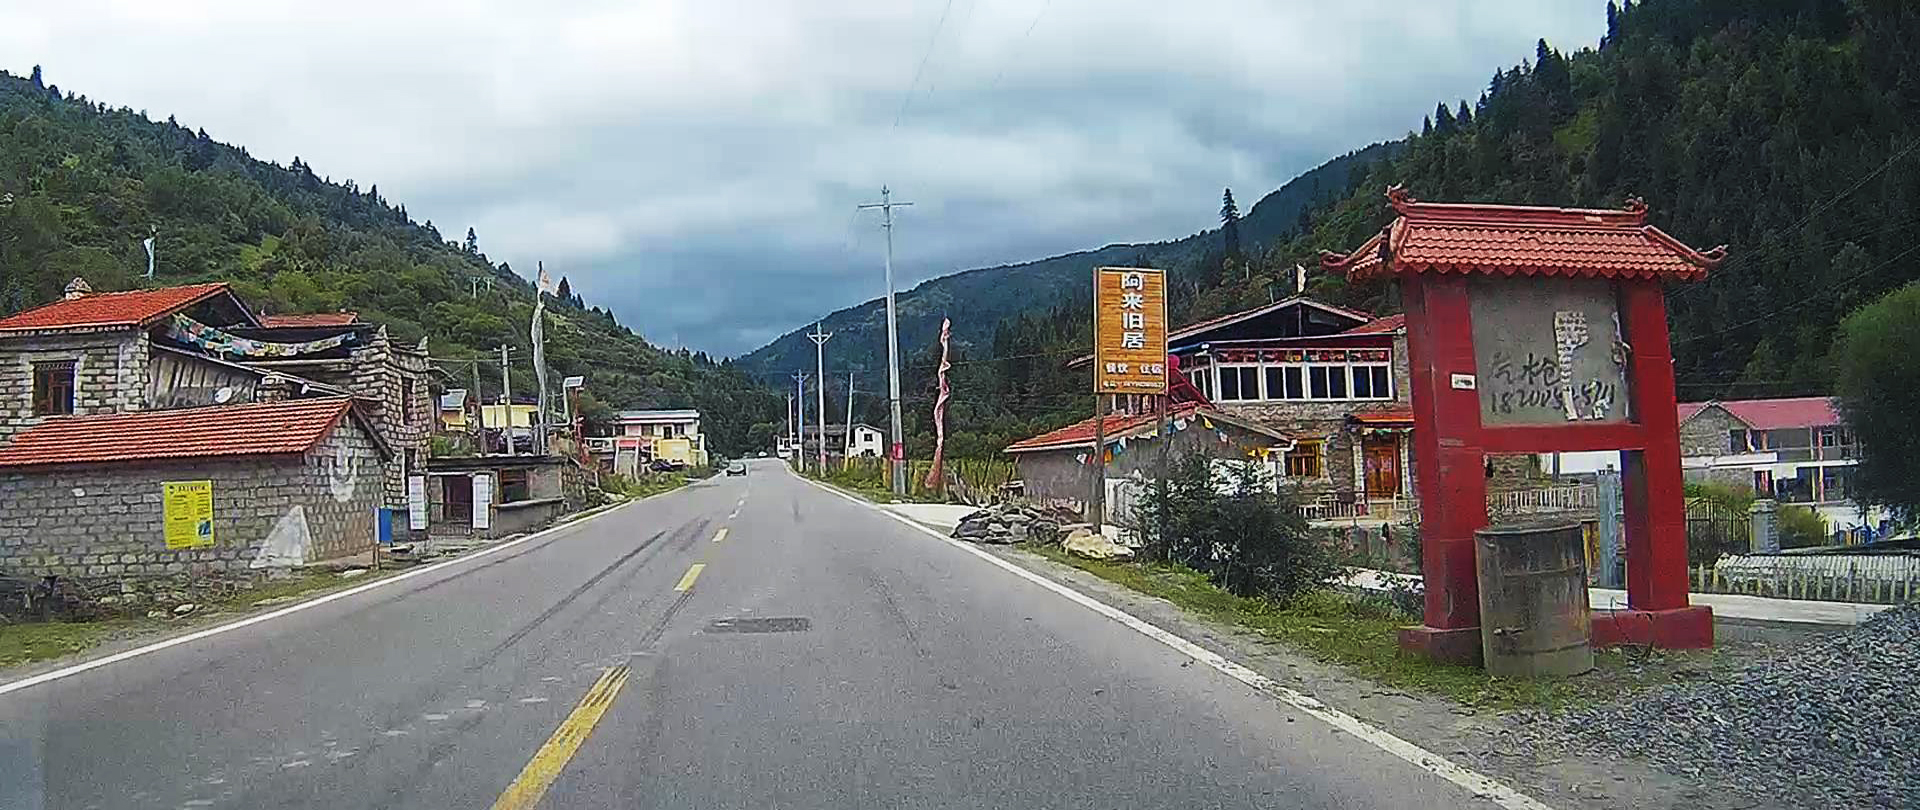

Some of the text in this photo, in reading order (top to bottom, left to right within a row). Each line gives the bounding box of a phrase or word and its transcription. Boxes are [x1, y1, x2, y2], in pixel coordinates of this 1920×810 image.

[1120, 271, 1145, 349] 阿来旧居
[1105, 362, 1162, 374] 餐饮 住宿
